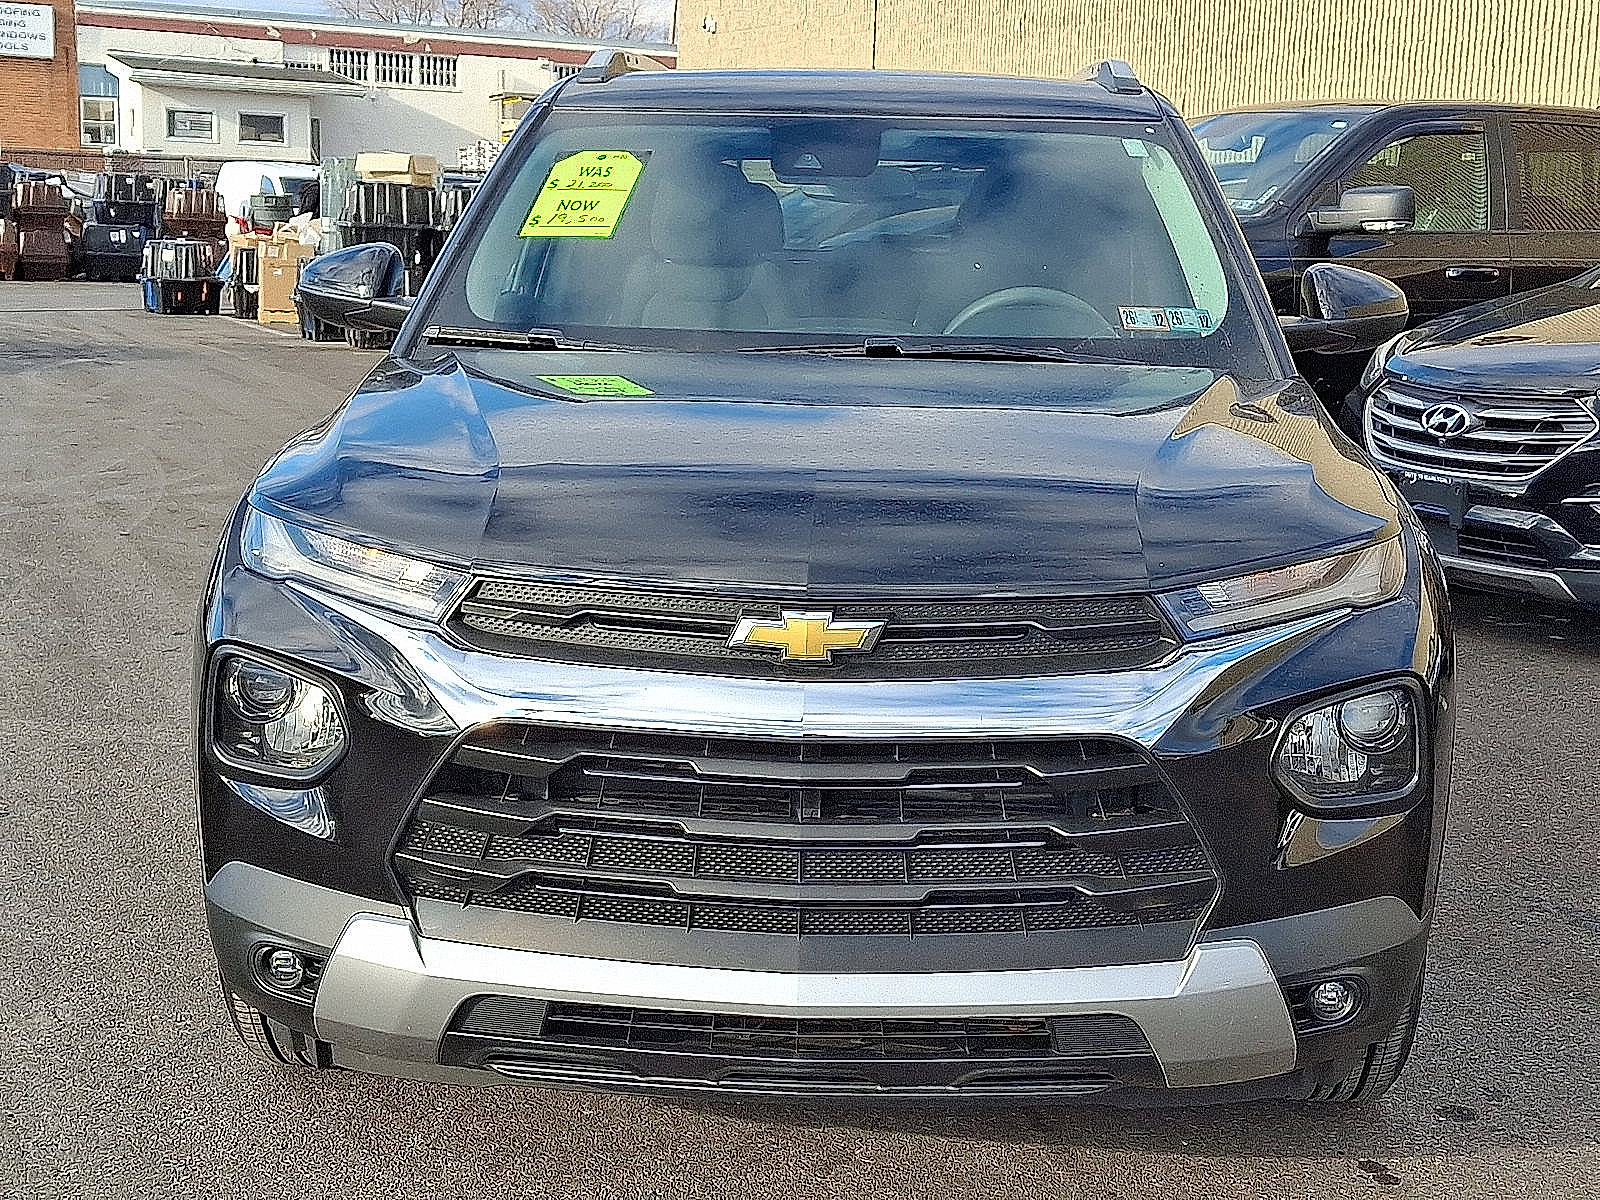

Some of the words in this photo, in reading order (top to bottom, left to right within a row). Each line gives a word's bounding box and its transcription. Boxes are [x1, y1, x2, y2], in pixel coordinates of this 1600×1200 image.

[578, 166, 613, 178] WAS
[546, 178, 559, 191] $
[556, 199, 601, 212] NOW
[528, 214, 541, 227] $
